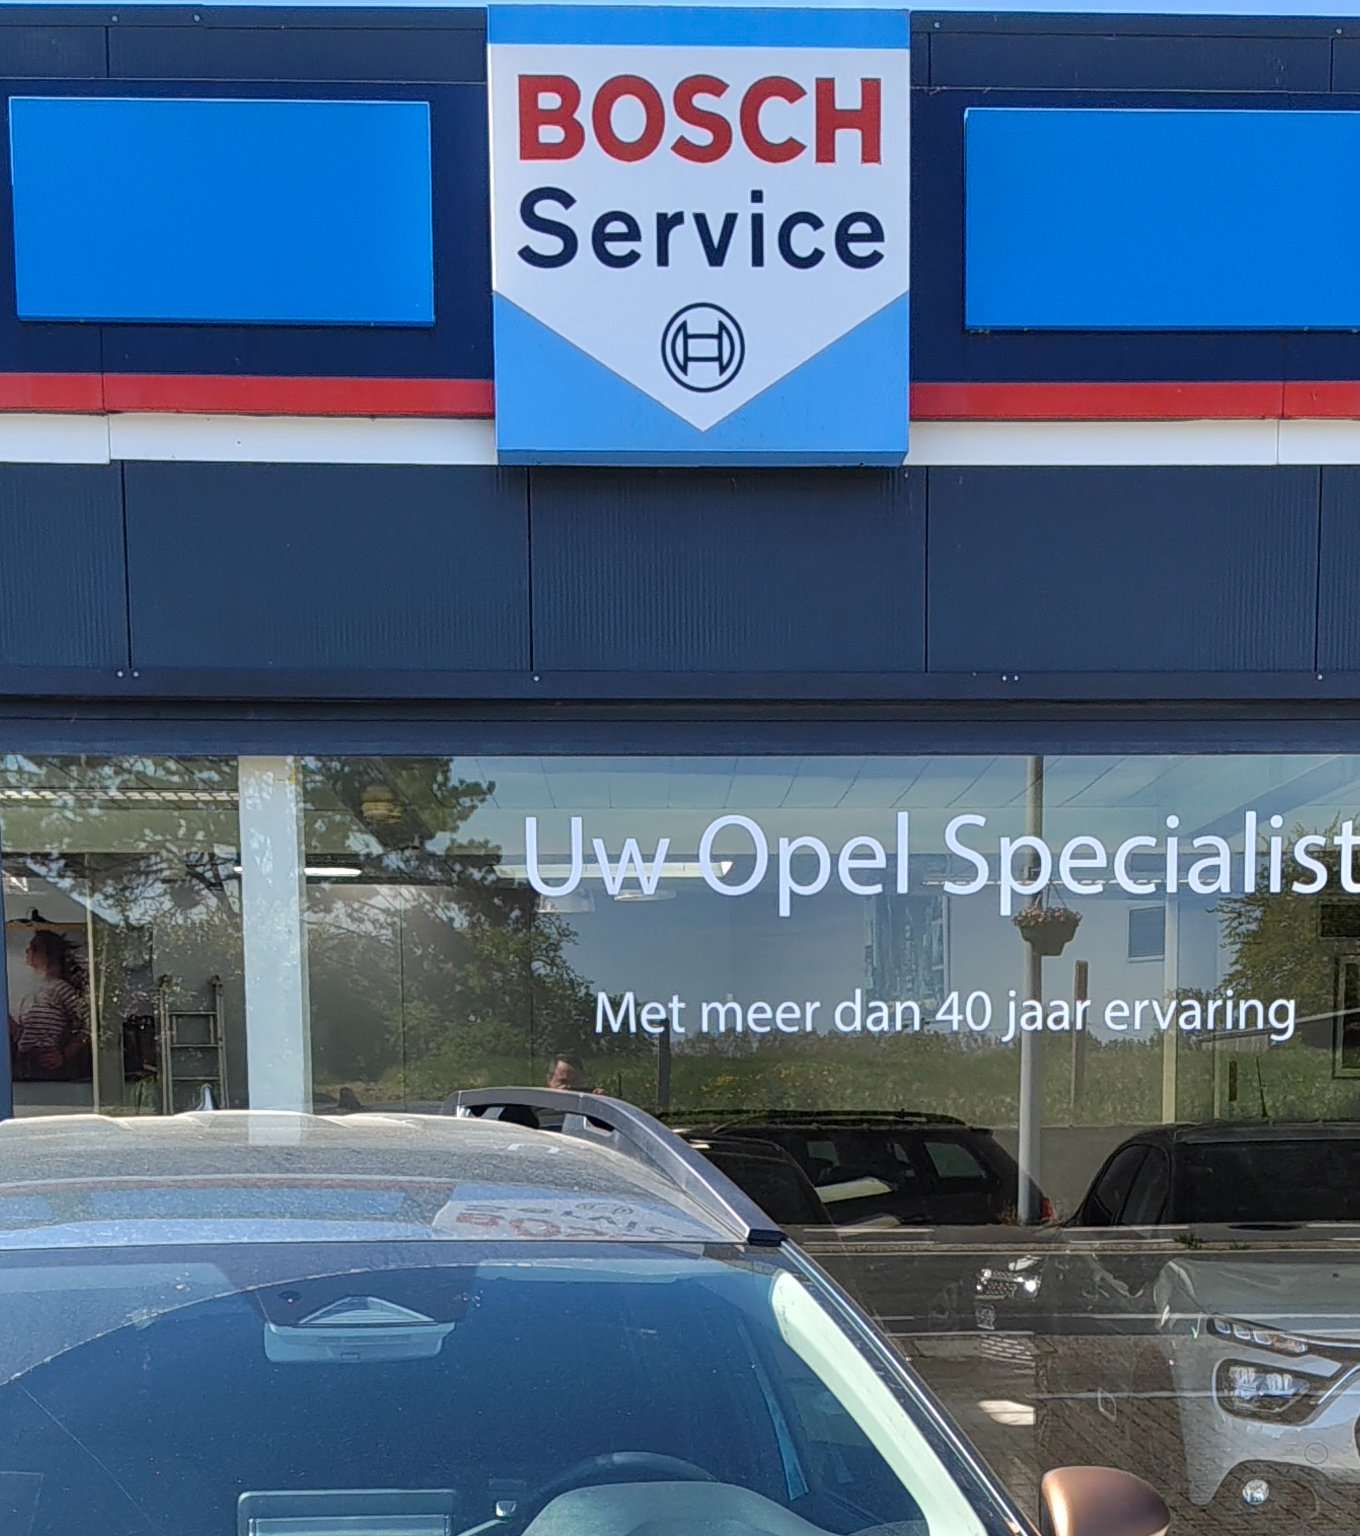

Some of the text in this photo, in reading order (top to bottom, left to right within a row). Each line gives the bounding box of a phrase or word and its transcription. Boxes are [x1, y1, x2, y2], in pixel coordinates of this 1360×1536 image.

[518, 74, 882, 165] BOSCH
[517, 186, 885, 270] Service
[525, 815, 670, 898] Uw
[699, 811, 909, 917] Opel
[596, 988, 1296, 1043] Met meer dan 40 jaar ervaring
